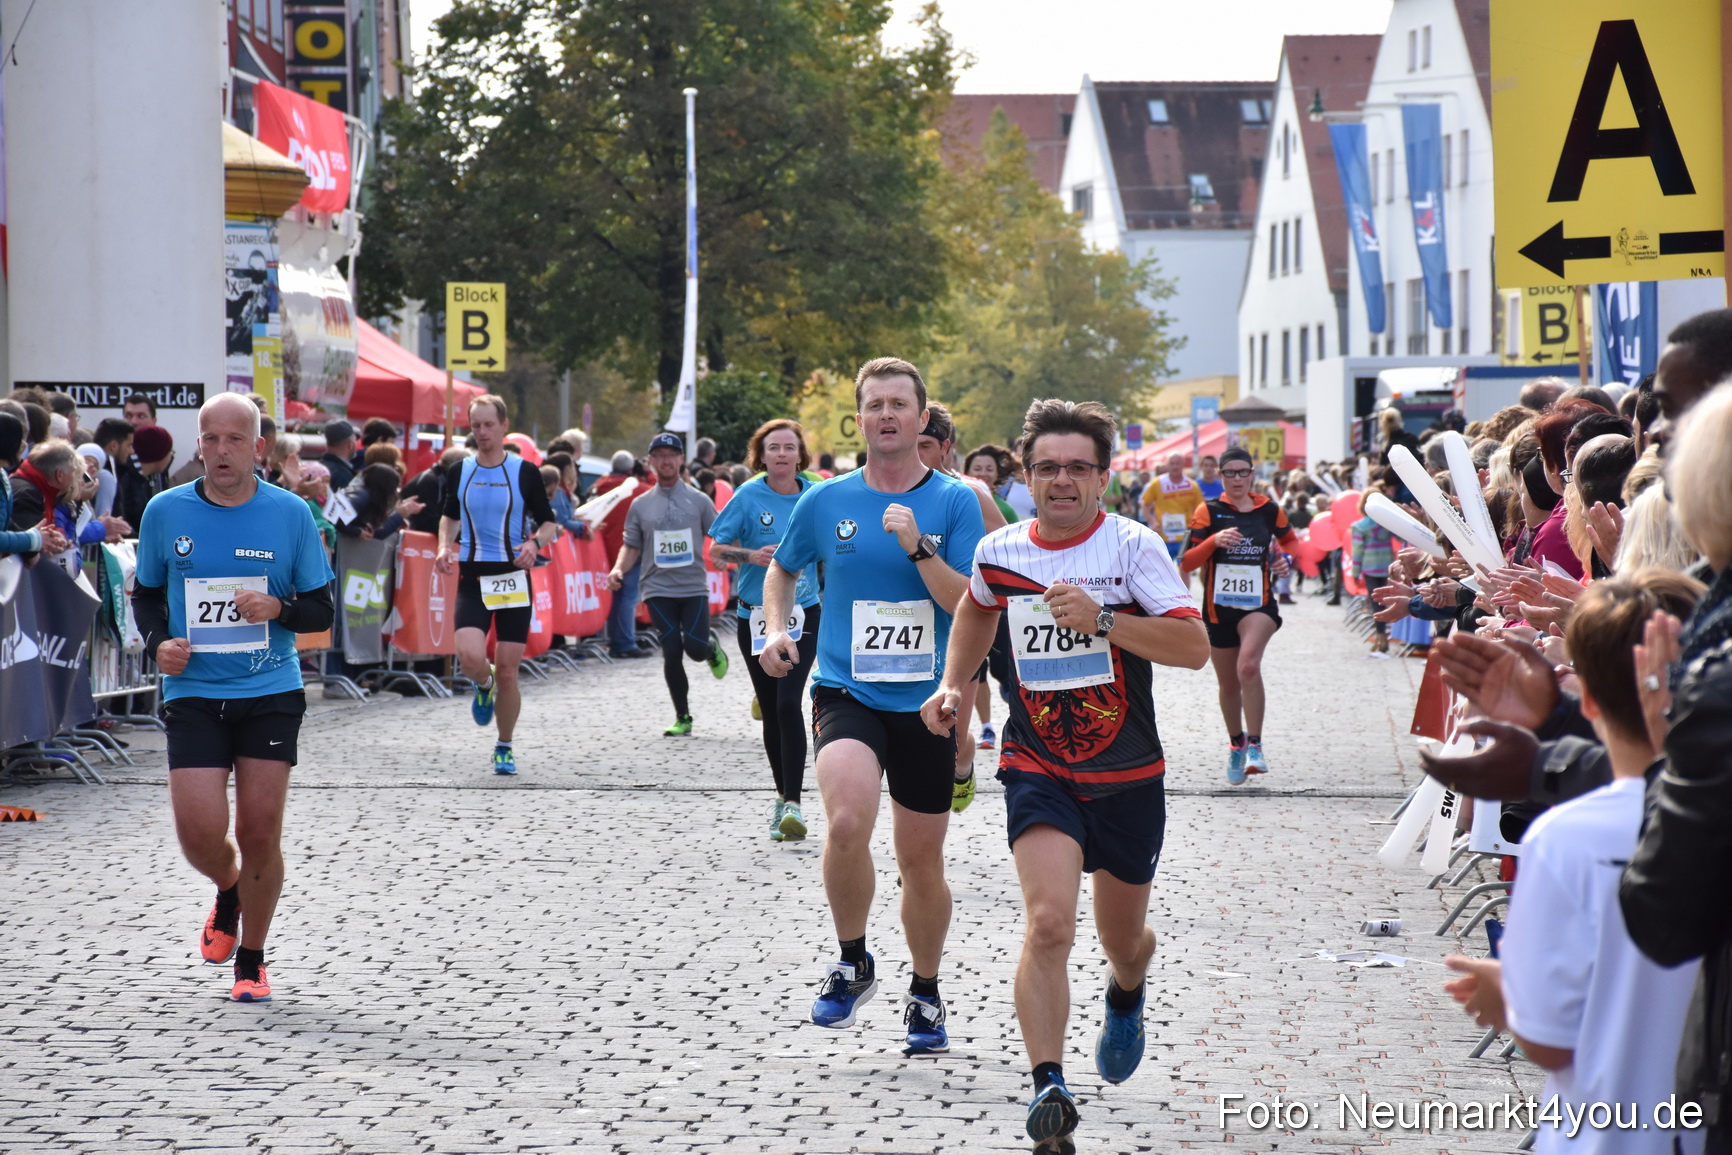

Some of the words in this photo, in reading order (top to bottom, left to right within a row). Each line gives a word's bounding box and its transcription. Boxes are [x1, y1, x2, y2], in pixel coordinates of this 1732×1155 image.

[1547, 19, 1697, 203] A
[453, 287, 498, 302] Block
[462, 310, 490, 351] B
[1539, 303, 1569, 345] B
[840, 415, 856, 438] C
[1268, 438, 1279, 455] D
[235, 549, 274, 559] BOCK
[660, 541, 687, 553] 2160
[1226, 546, 1265, 555] DESIGN
[492, 579, 517, 593] 279
[1061, 577, 1113, 587] NEUMARKT
[1222, 578, 1254, 592] 2181
[198, 601, 241, 623] 273
[884, 608, 914, 616] BOCK
[757, 616, 797, 636] 29
[865, 625, 924, 650] 2747
[1023, 624, 1093, 653] 2784
[1024, 659, 1086, 676] GERHARD
